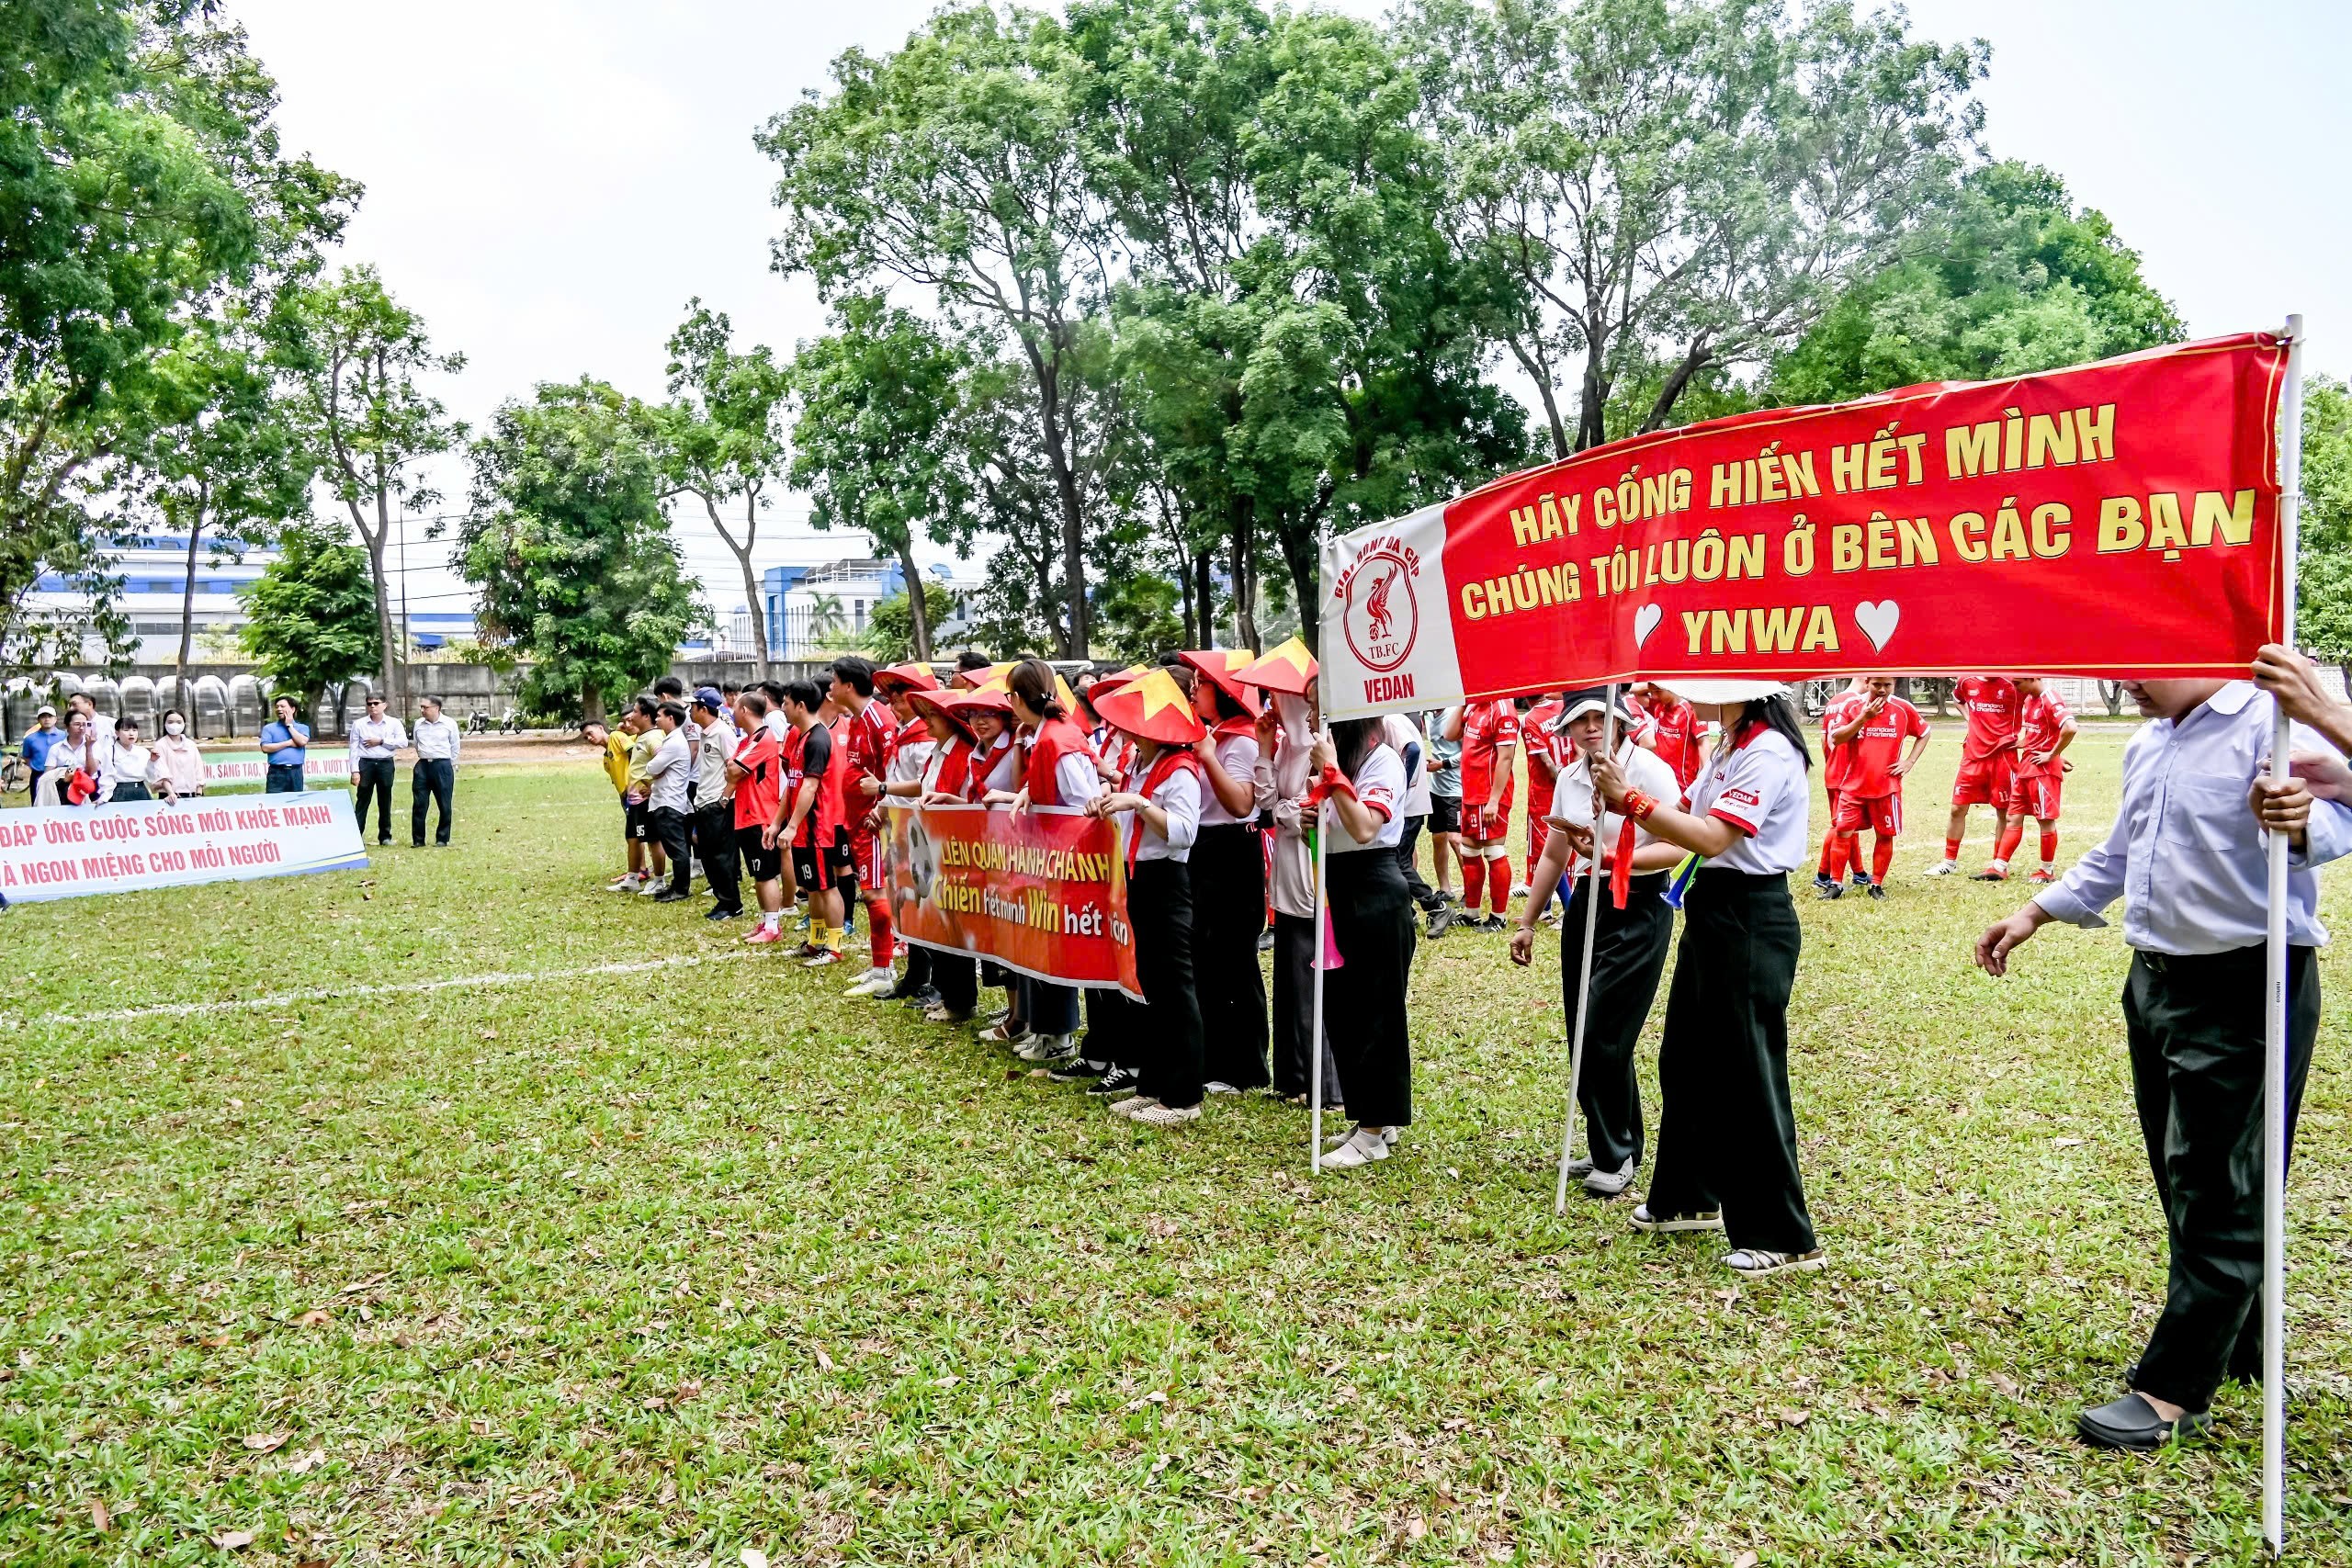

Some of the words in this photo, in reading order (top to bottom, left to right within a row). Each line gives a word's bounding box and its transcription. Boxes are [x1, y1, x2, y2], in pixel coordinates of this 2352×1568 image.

[1509, 492, 1582, 548] HÃY
[1593, 465, 1693, 530] CỐNG
[1709, 441, 1822, 509] HIẾN
[1831, 421, 1928, 494] HẾT
[1944, 403, 2117, 480] MÌNH
[1461, 562, 1582, 622] CHÚNG
[1590, 545, 1640, 598] TÔI
[1643, 528, 1767, 588] LUÔN
[1783, 513, 1817, 578] Ở
[1831, 511, 1939, 574] BÊN
[1949, 497, 2072, 562] CÁC
[2096, 489, 2256, 562] BẠN
[1680, 605, 1841, 656] YNWA
[1368, 643, 1401, 660] TB.FC
[1363, 673, 1415, 704] VEDAN
[217, 761, 241, 780] SÁNG
[1728, 789, 1754, 804] VEDAN
[0, 820, 39, 848] ĐÁP
[43, 818, 85, 845] ỨNG
[89, 814, 141, 844] CUỘC
[144, 807, 195, 838] SỐNG
[198, 808, 233, 833] MỚI
[234, 803, 281, 830] KHỎE
[282, 806, 333, 829] MẠNH
[1884, 815, 1893, 829] 9
[21, 859, 79, 885] NGON
[82, 852, 146, 882] MIỆNG
[149, 850, 187, 874] CHO
[189, 840, 226, 870] MỖI
[228, 838, 282, 866] NGƯỜI
[842, 843, 849, 857] 8
[941, 836, 970, 867] LIÊN
[972, 838, 1007, 872] QUÂN
[1009, 840, 1046, 877] HÀNH
[1046, 845, 1111, 883] CHÁNH
[801, 863, 813, 880] 19
[932, 871, 980, 913] Chiến
[1028, 887, 1059, 933] Win
[1064, 901, 1102, 936] hết
